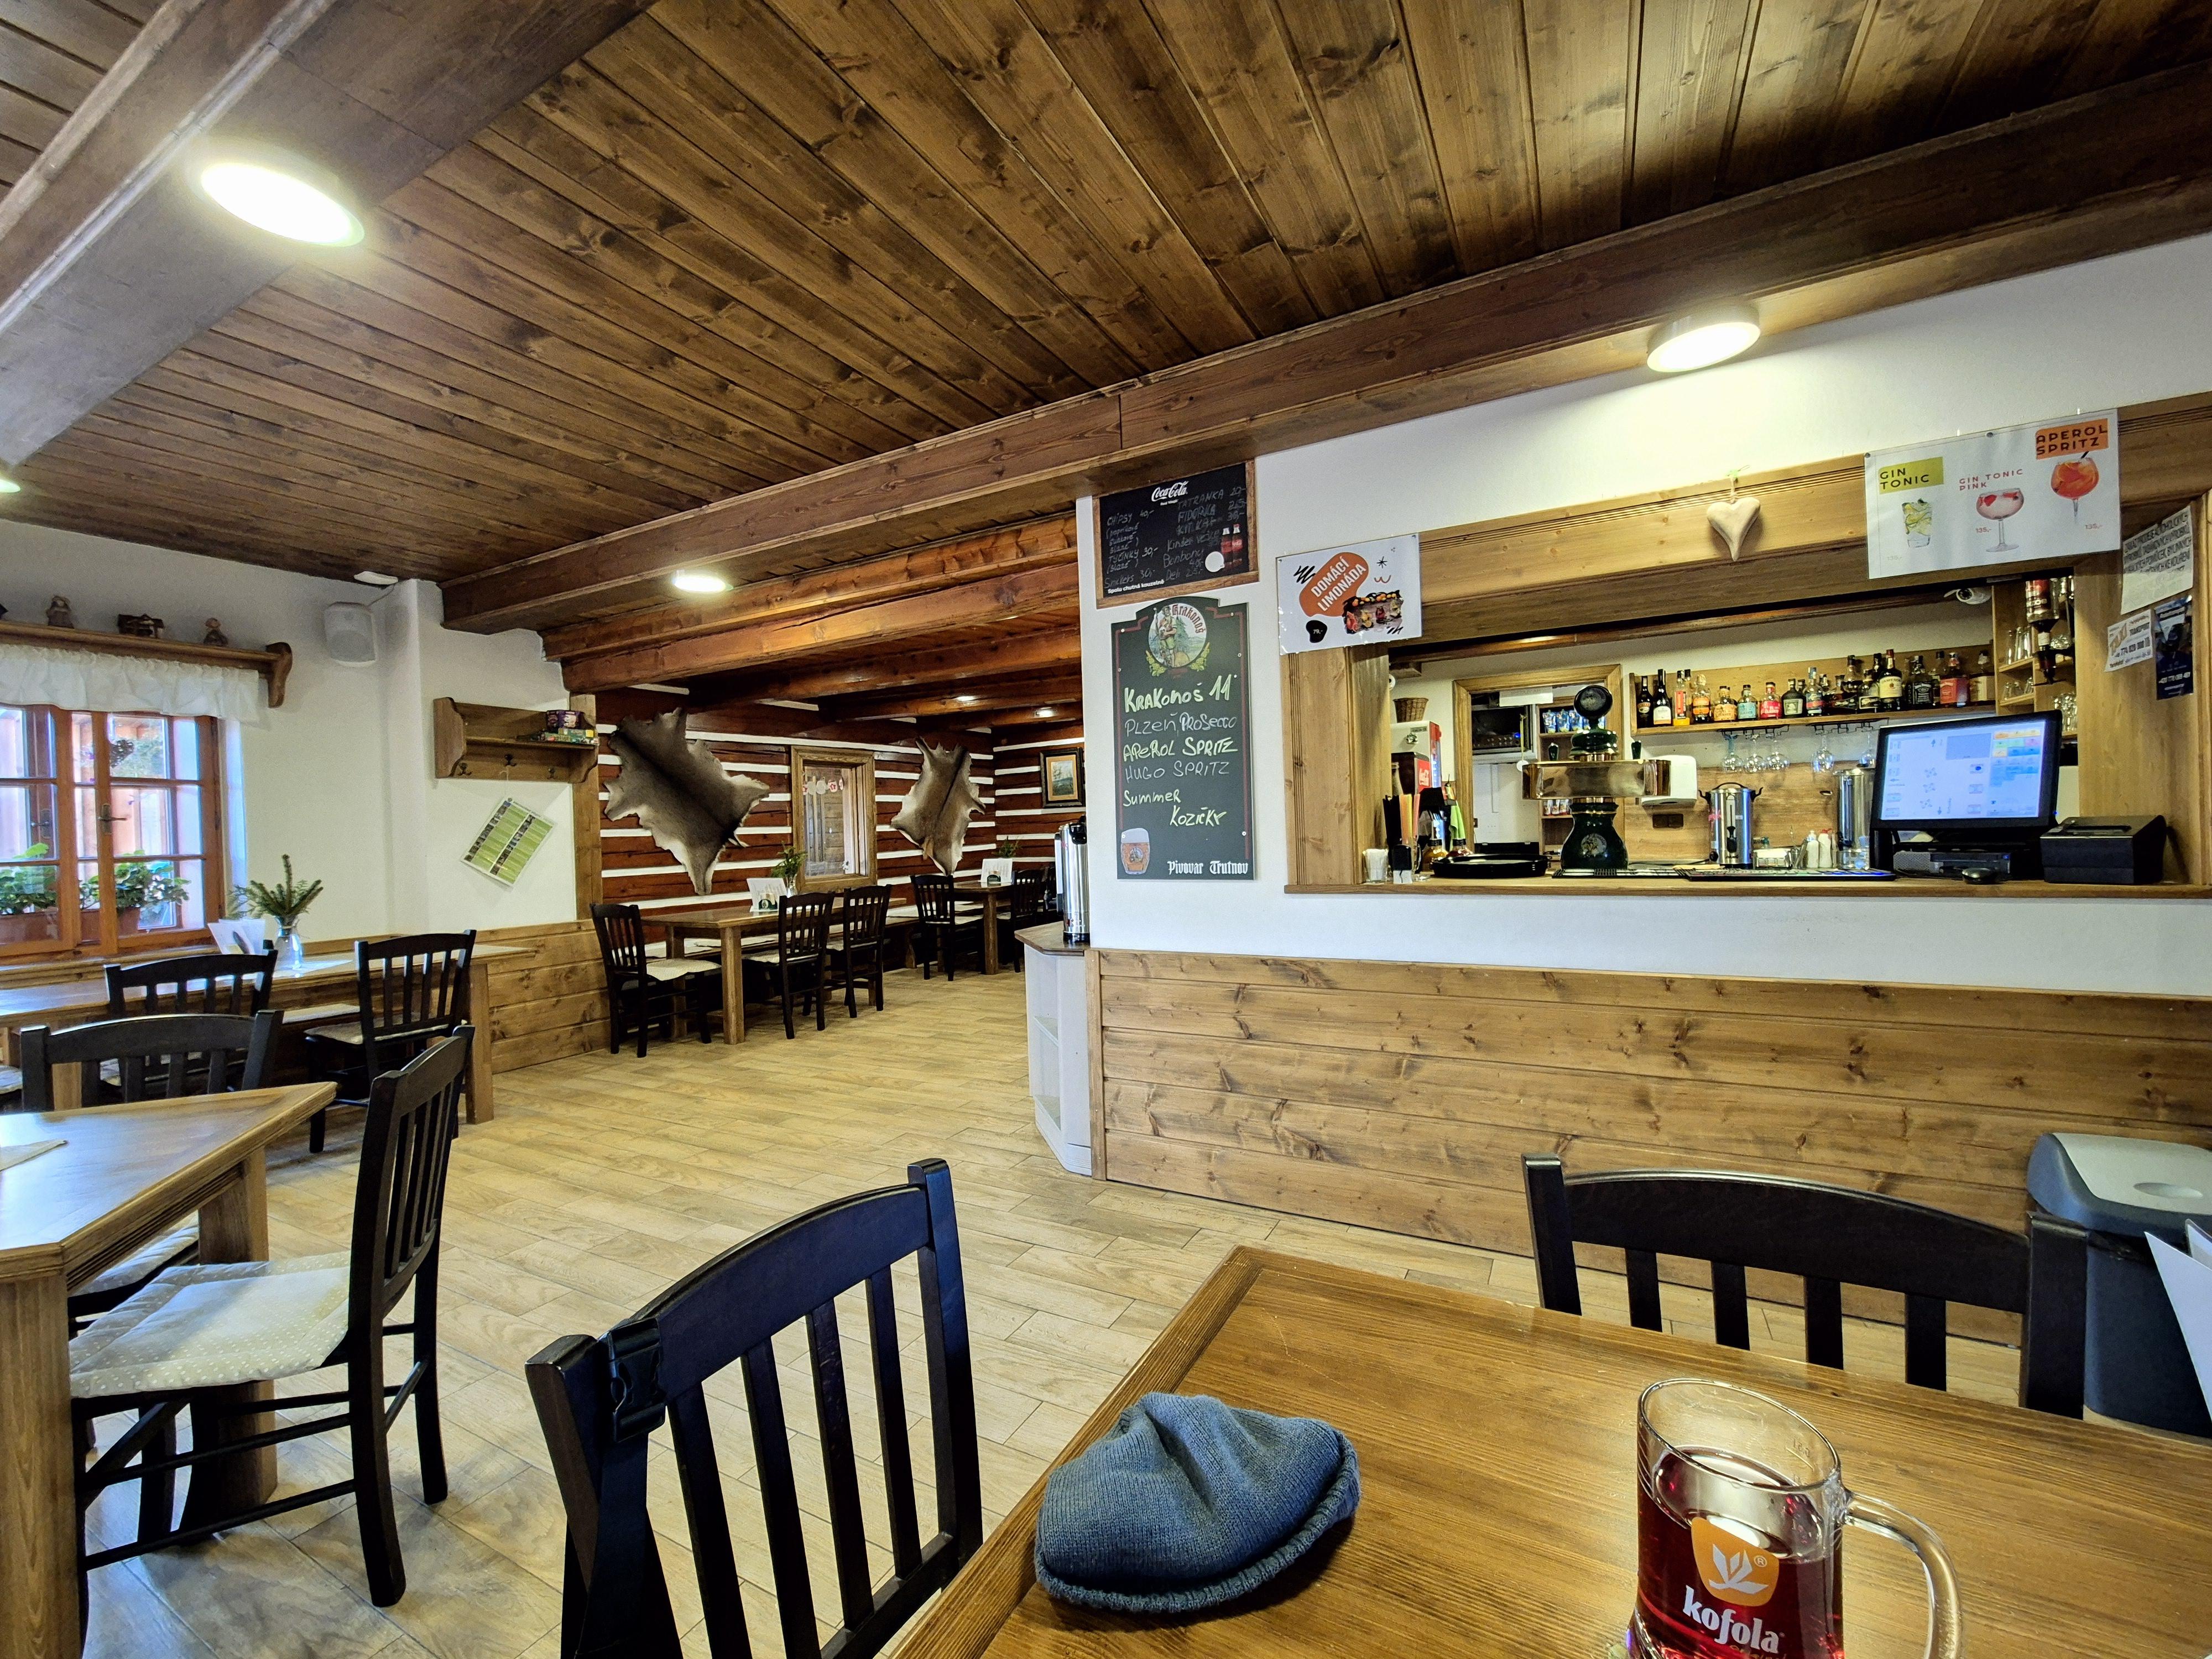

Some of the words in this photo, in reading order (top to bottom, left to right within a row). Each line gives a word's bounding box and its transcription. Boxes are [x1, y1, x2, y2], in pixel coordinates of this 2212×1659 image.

[2036, 423, 2109, 444] APEROL
[2036, 437, 2100, 456] SPRITZ
[1880, 467, 1906, 481] GIN
[1880, 474, 1929, 490] TONIC
[1959, 476, 1984, 484] GIN
[1986, 469, 2024, 481] TONIC
[1959, 482, 1987, 491] PINK
[1167, 537, 1193, 552] Kinder
[1311, 556, 1350, 598] DOMÁCÍ
[1317, 563, 1366, 612] LIMONÁDA
[1182, 737, 1238, 756] SPRITZ
[1125, 765, 1165, 784] HUGO
[1172, 761, 1229, 776] SPRITZ
[1167, 860, 1203, 876] Pivovar
[1209, 859, 1249, 875] Trutnov
[1683, 1585, 1779, 1653] kofola
